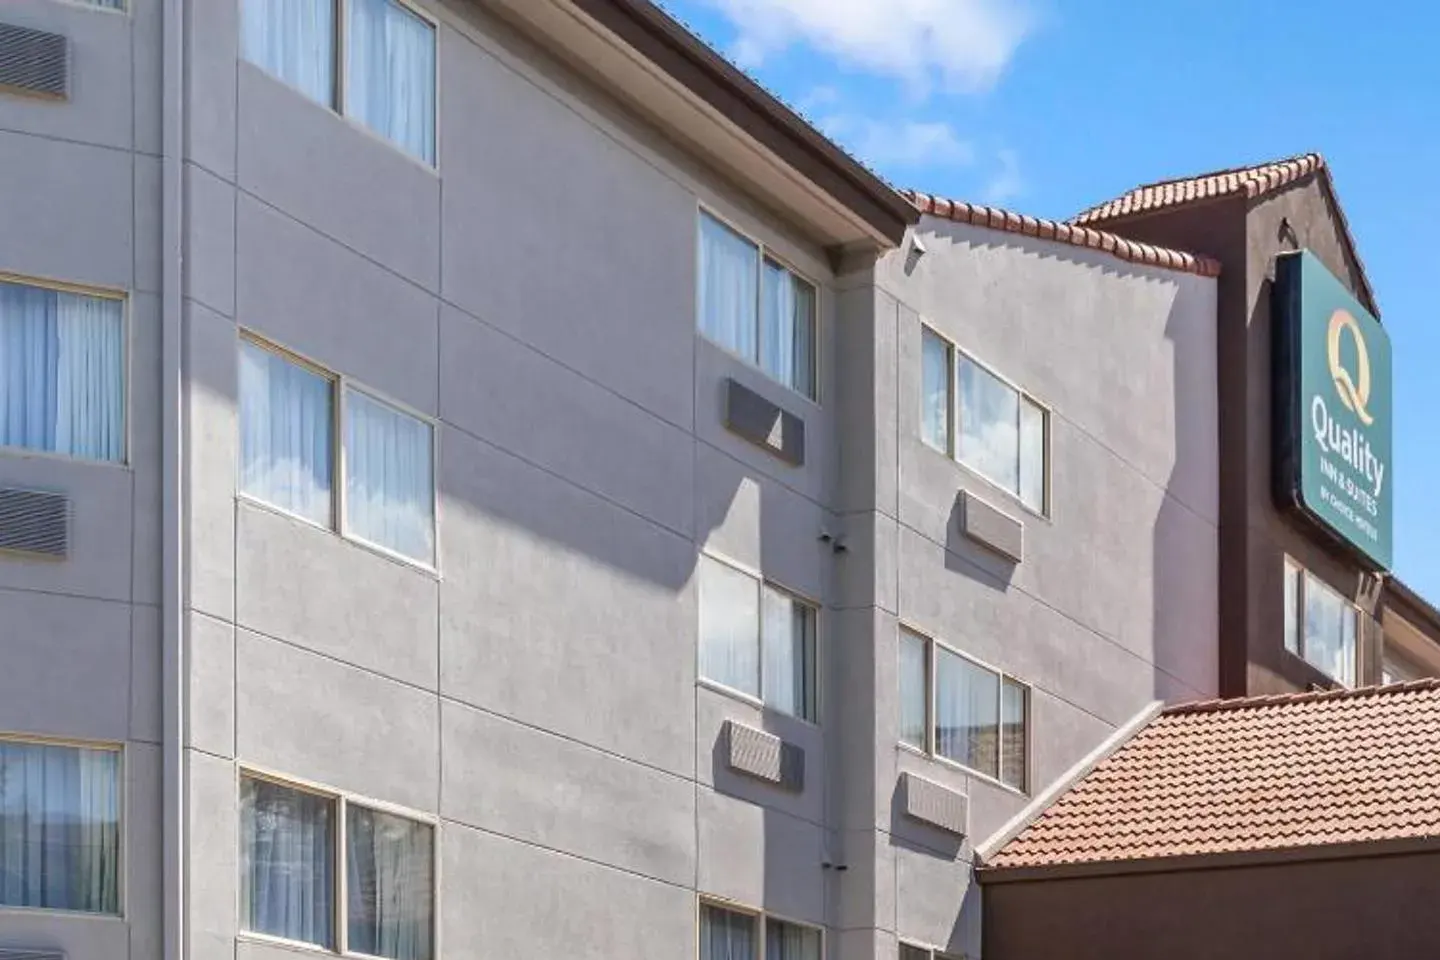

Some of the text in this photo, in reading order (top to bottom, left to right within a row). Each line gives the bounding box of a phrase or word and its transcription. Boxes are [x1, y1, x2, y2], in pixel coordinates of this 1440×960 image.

[1327, 307, 1374, 425] Q
[1312, 394, 1384, 497] Quality
[1320, 455, 1377, 517] INN & SUITES
